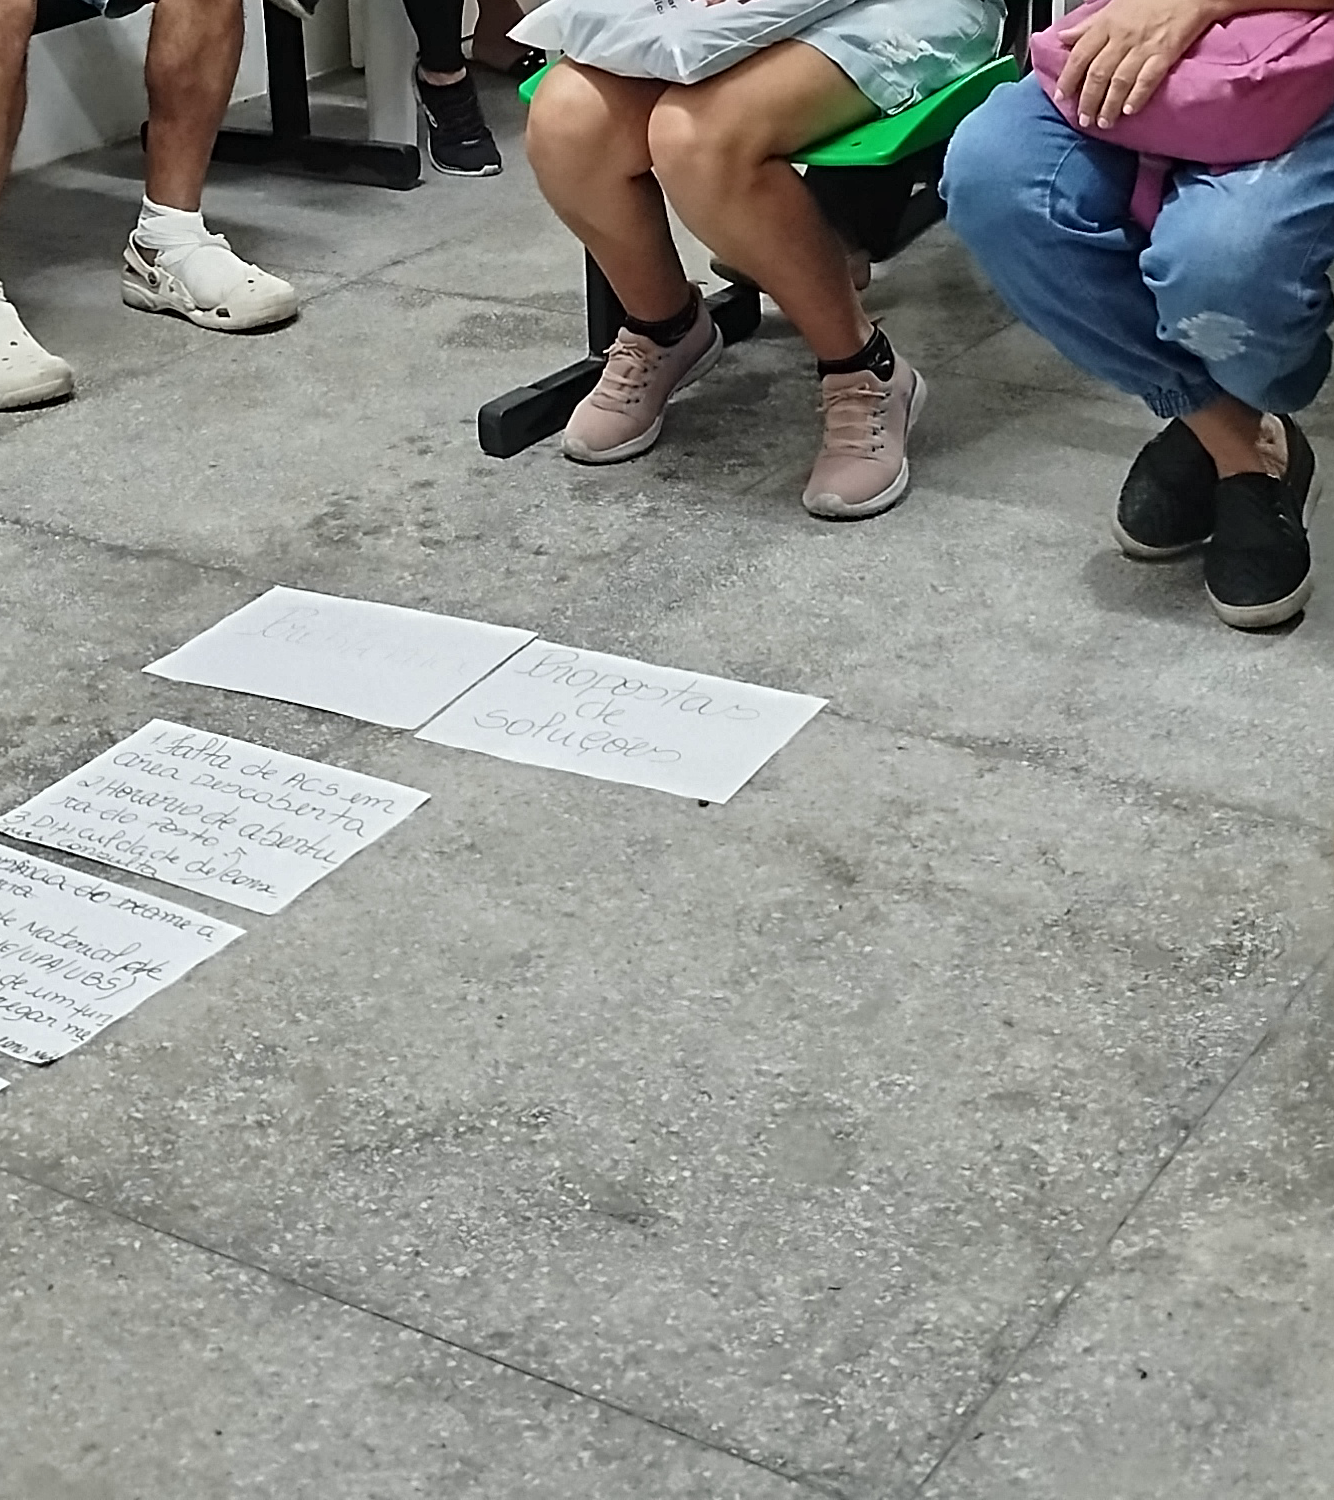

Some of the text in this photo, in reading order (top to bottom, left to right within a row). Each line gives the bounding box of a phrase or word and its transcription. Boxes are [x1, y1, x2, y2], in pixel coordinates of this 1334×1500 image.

[518, 649, 759, 715] Propostas
[281, 772, 339, 796] ACS
[30, 814, 179, 868] Dificuldade
